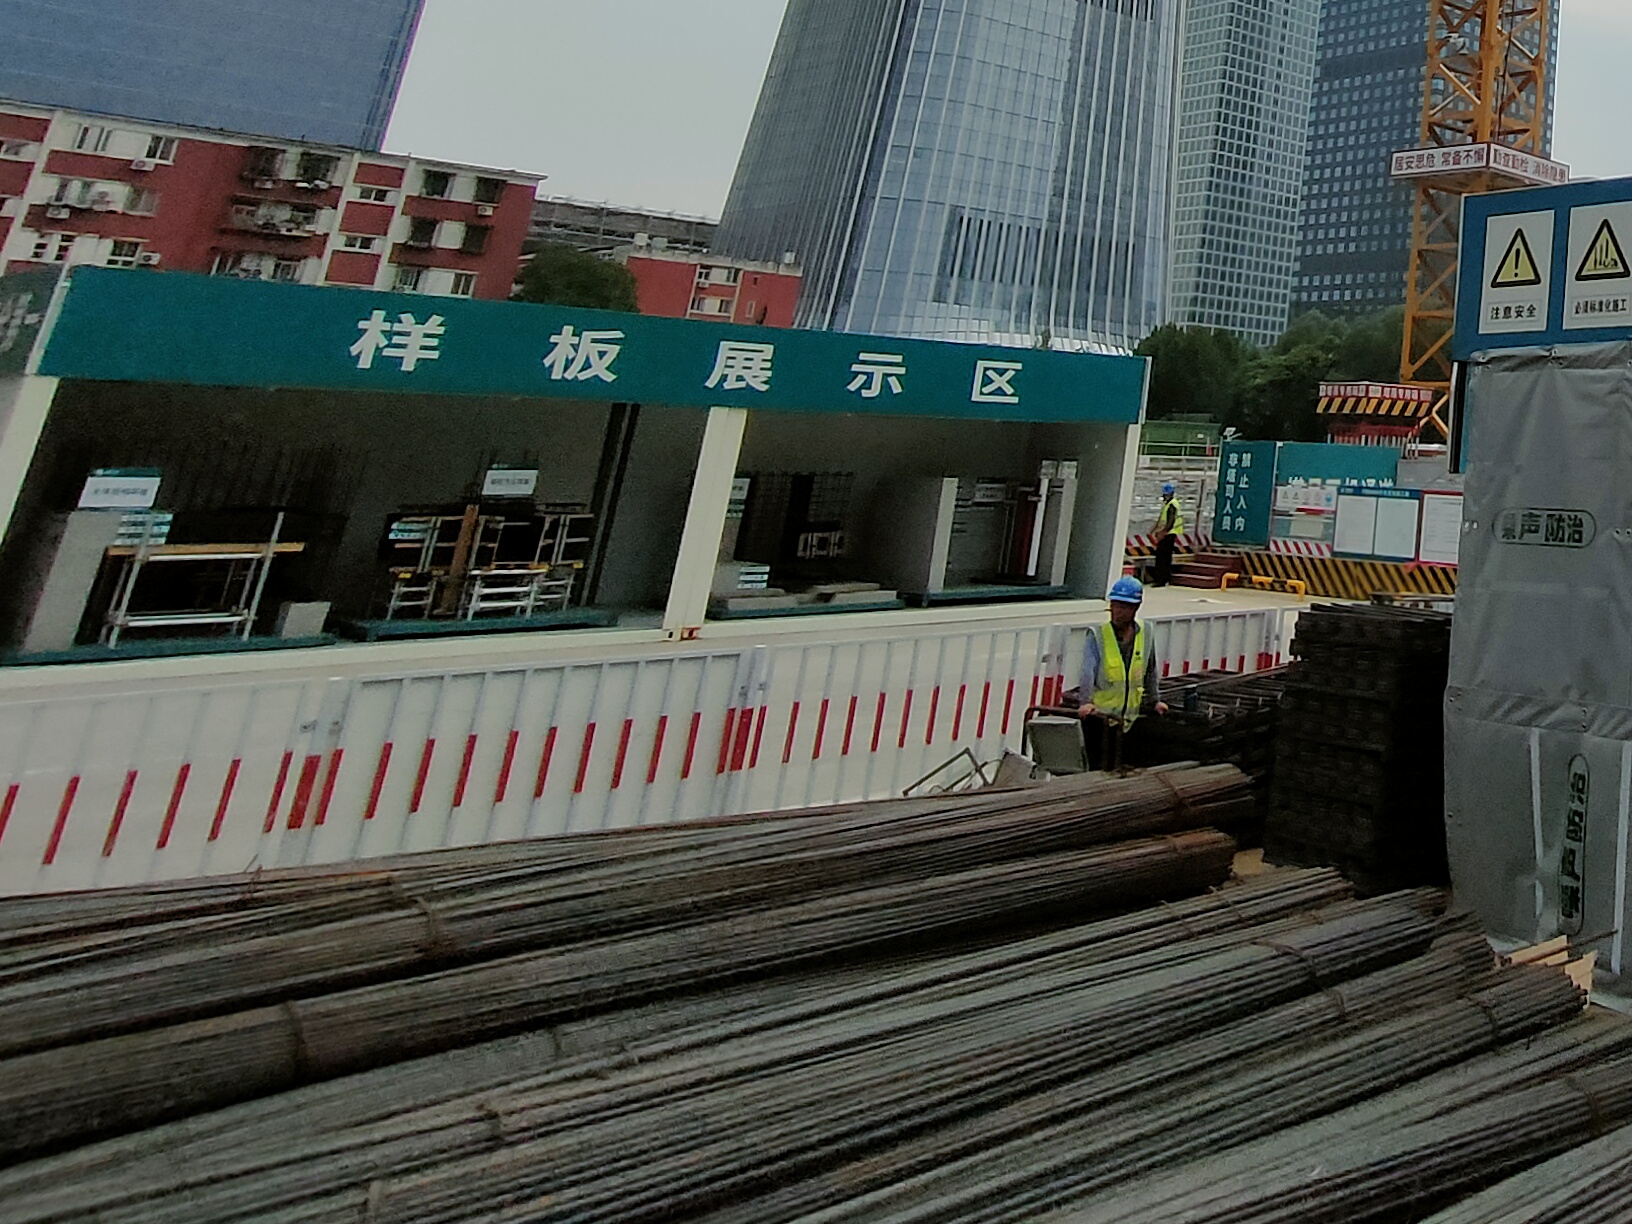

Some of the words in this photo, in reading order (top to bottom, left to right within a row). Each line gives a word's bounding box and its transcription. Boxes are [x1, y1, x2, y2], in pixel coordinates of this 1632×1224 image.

[1490, 304, 1538, 320] 注意安全
[350, 310, 1024, 405] 样板展示区
[1501, 511, 1585, 544] 噪声防治
